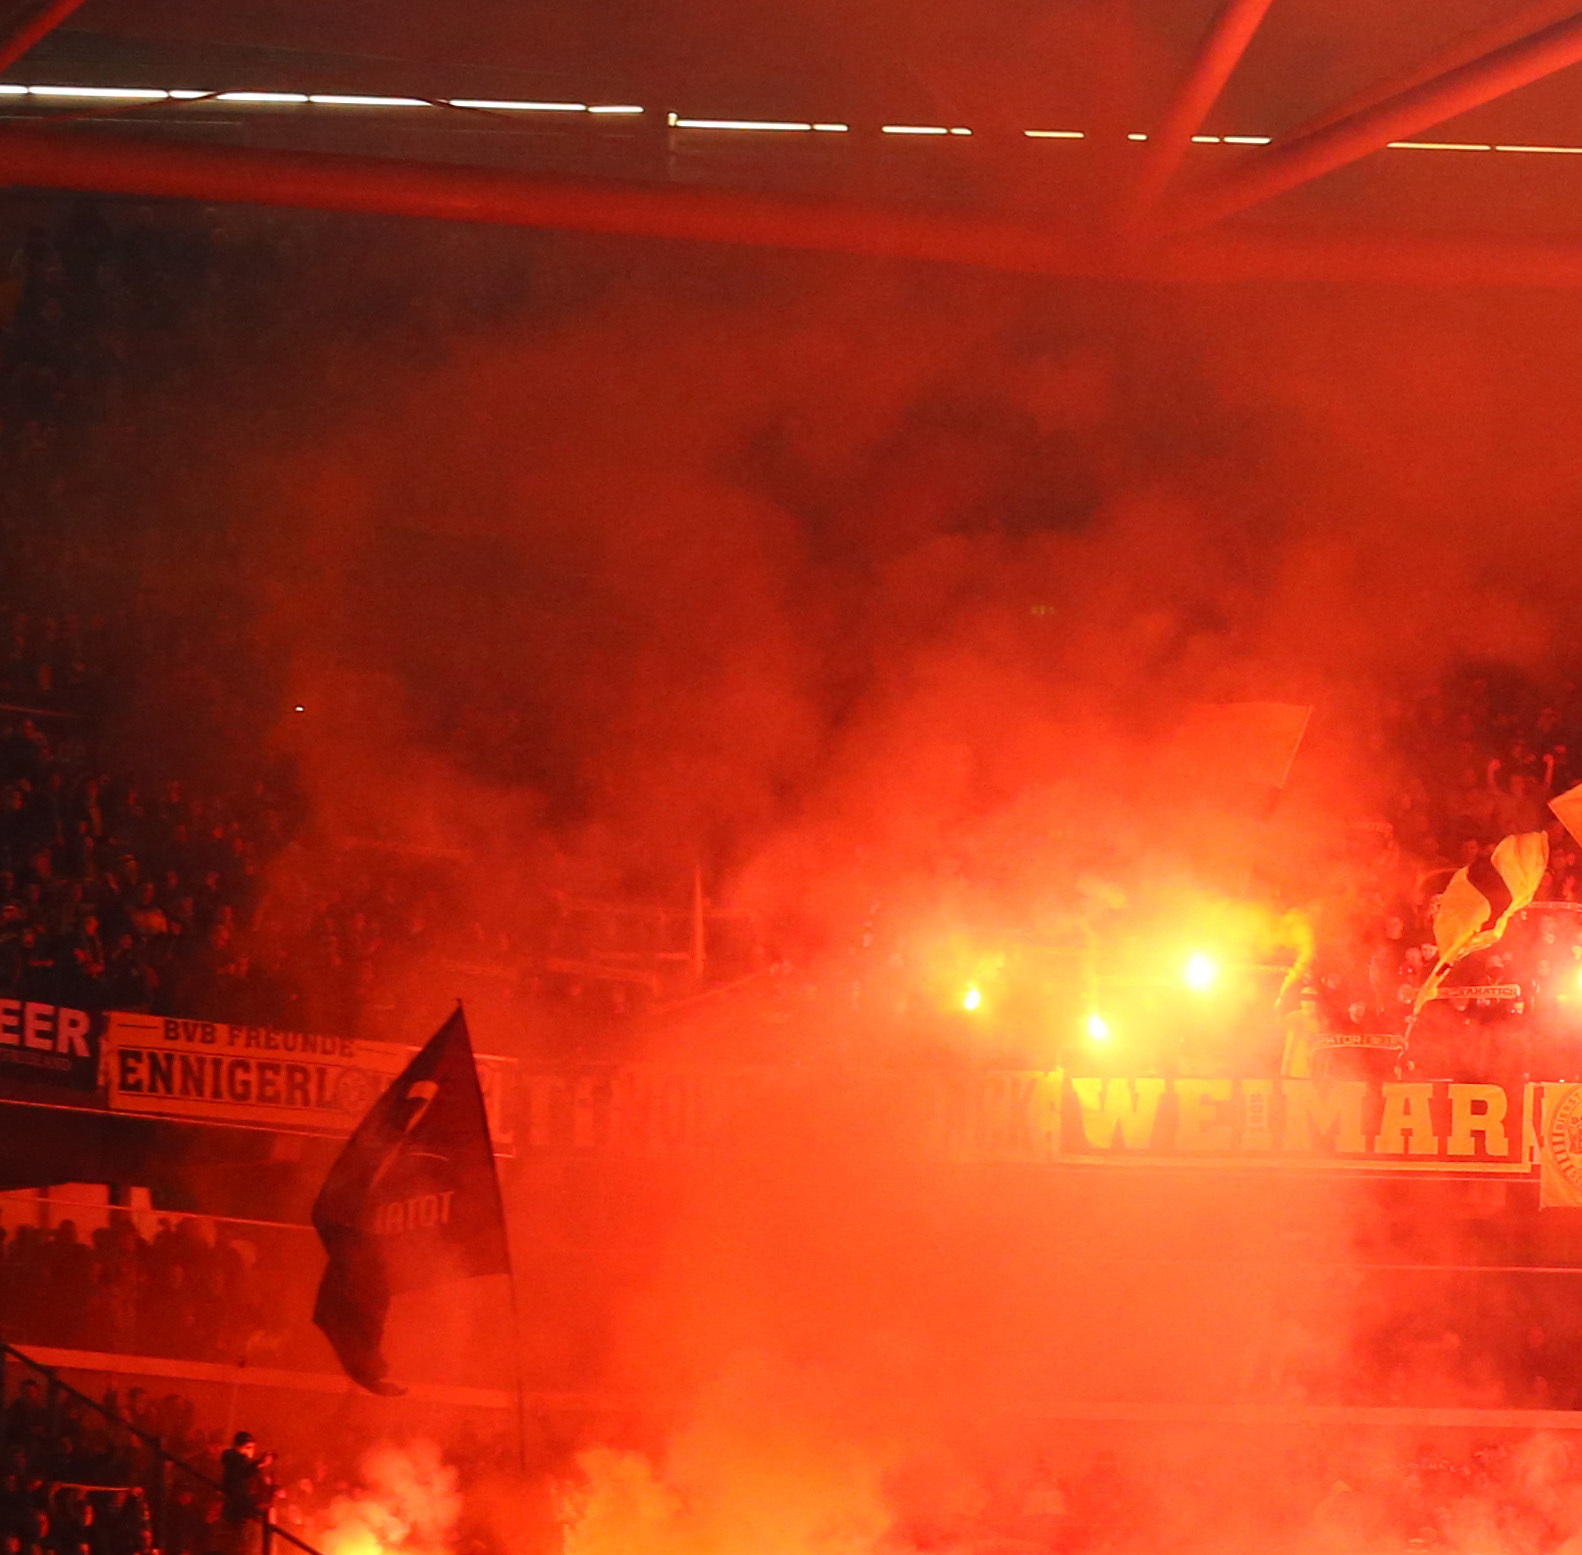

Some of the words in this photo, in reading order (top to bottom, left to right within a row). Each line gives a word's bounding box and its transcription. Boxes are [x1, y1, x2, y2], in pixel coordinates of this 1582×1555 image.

[163, 1018, 216, 1045] BVB
[226, 1027, 356, 1058] FREUNDE
[1071, 1078, 1510, 1158] WEIMAR
